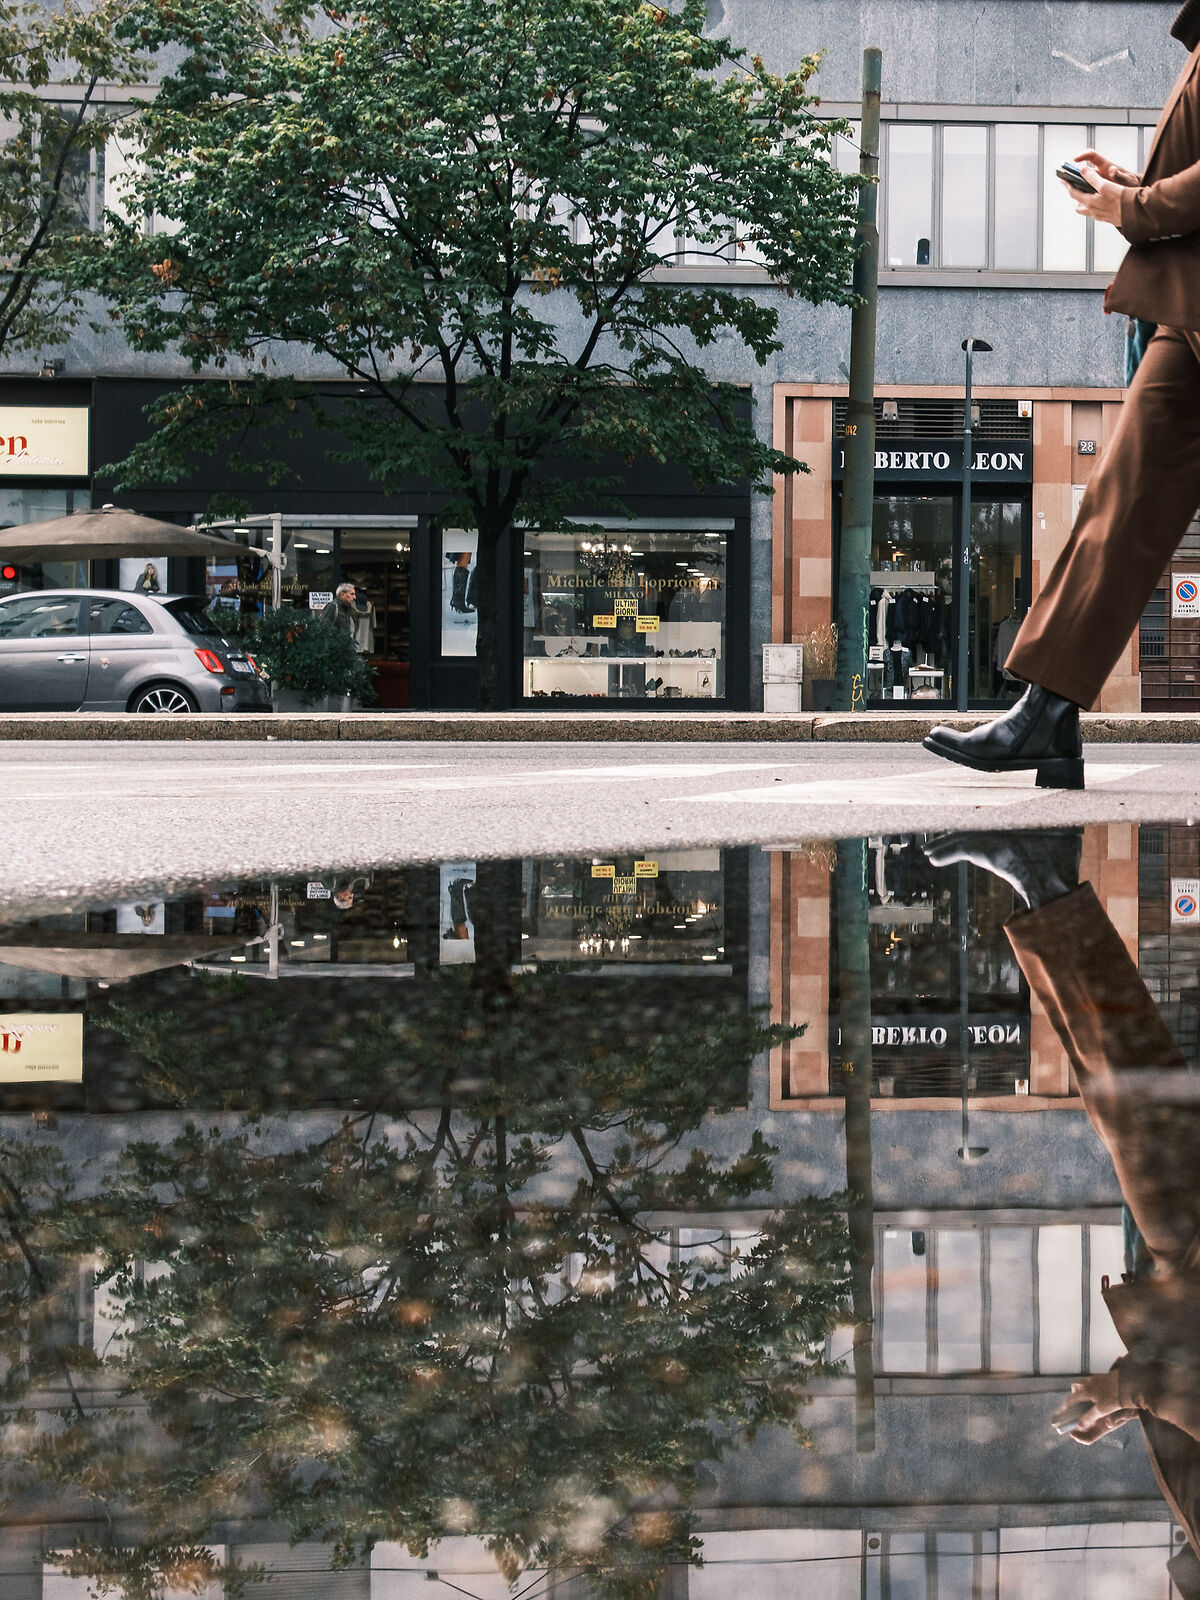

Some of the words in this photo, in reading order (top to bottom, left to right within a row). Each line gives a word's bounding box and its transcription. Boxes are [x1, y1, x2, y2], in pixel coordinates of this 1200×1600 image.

[1080, 441, 1094, 452] 28
[840, 450, 950, 470] BERTO
[547, 574, 605, 588] Michele
[280, 582, 310, 592] opriore
[605, 590, 644, 599] MILANO
[615, 600, 638, 608] ULTIMI
[615, 608, 638, 616] GIORNI
